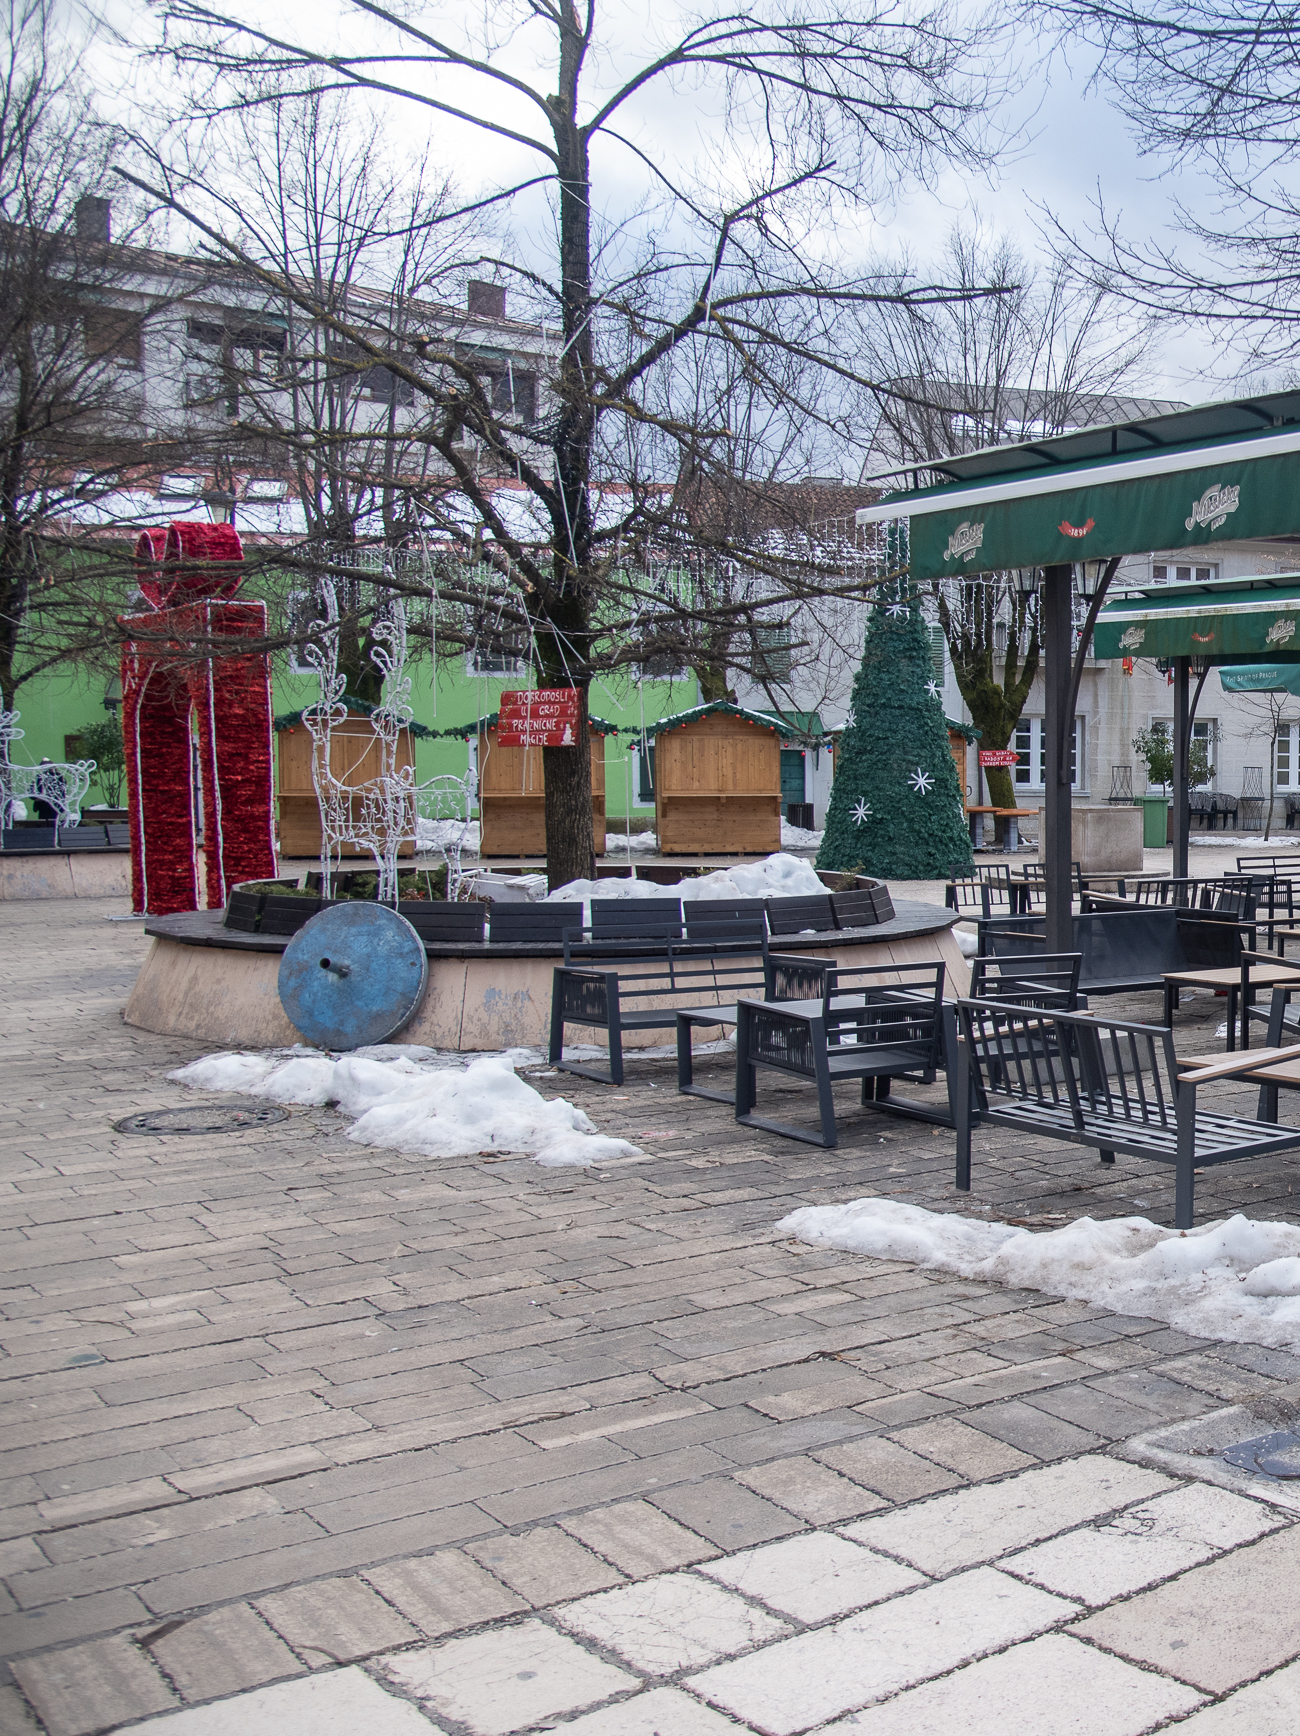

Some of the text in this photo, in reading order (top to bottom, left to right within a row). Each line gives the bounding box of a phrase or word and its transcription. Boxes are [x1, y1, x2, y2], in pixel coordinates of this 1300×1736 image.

[1237, 674, 1252, 682] SPIRIT
[1259, 671, 1278, 679] PRAGUE
[520, 705, 561, 716] U GRAD
[511, 717, 558, 732] PRAZNIČNE
[520, 732, 549, 746] MAGIJE
